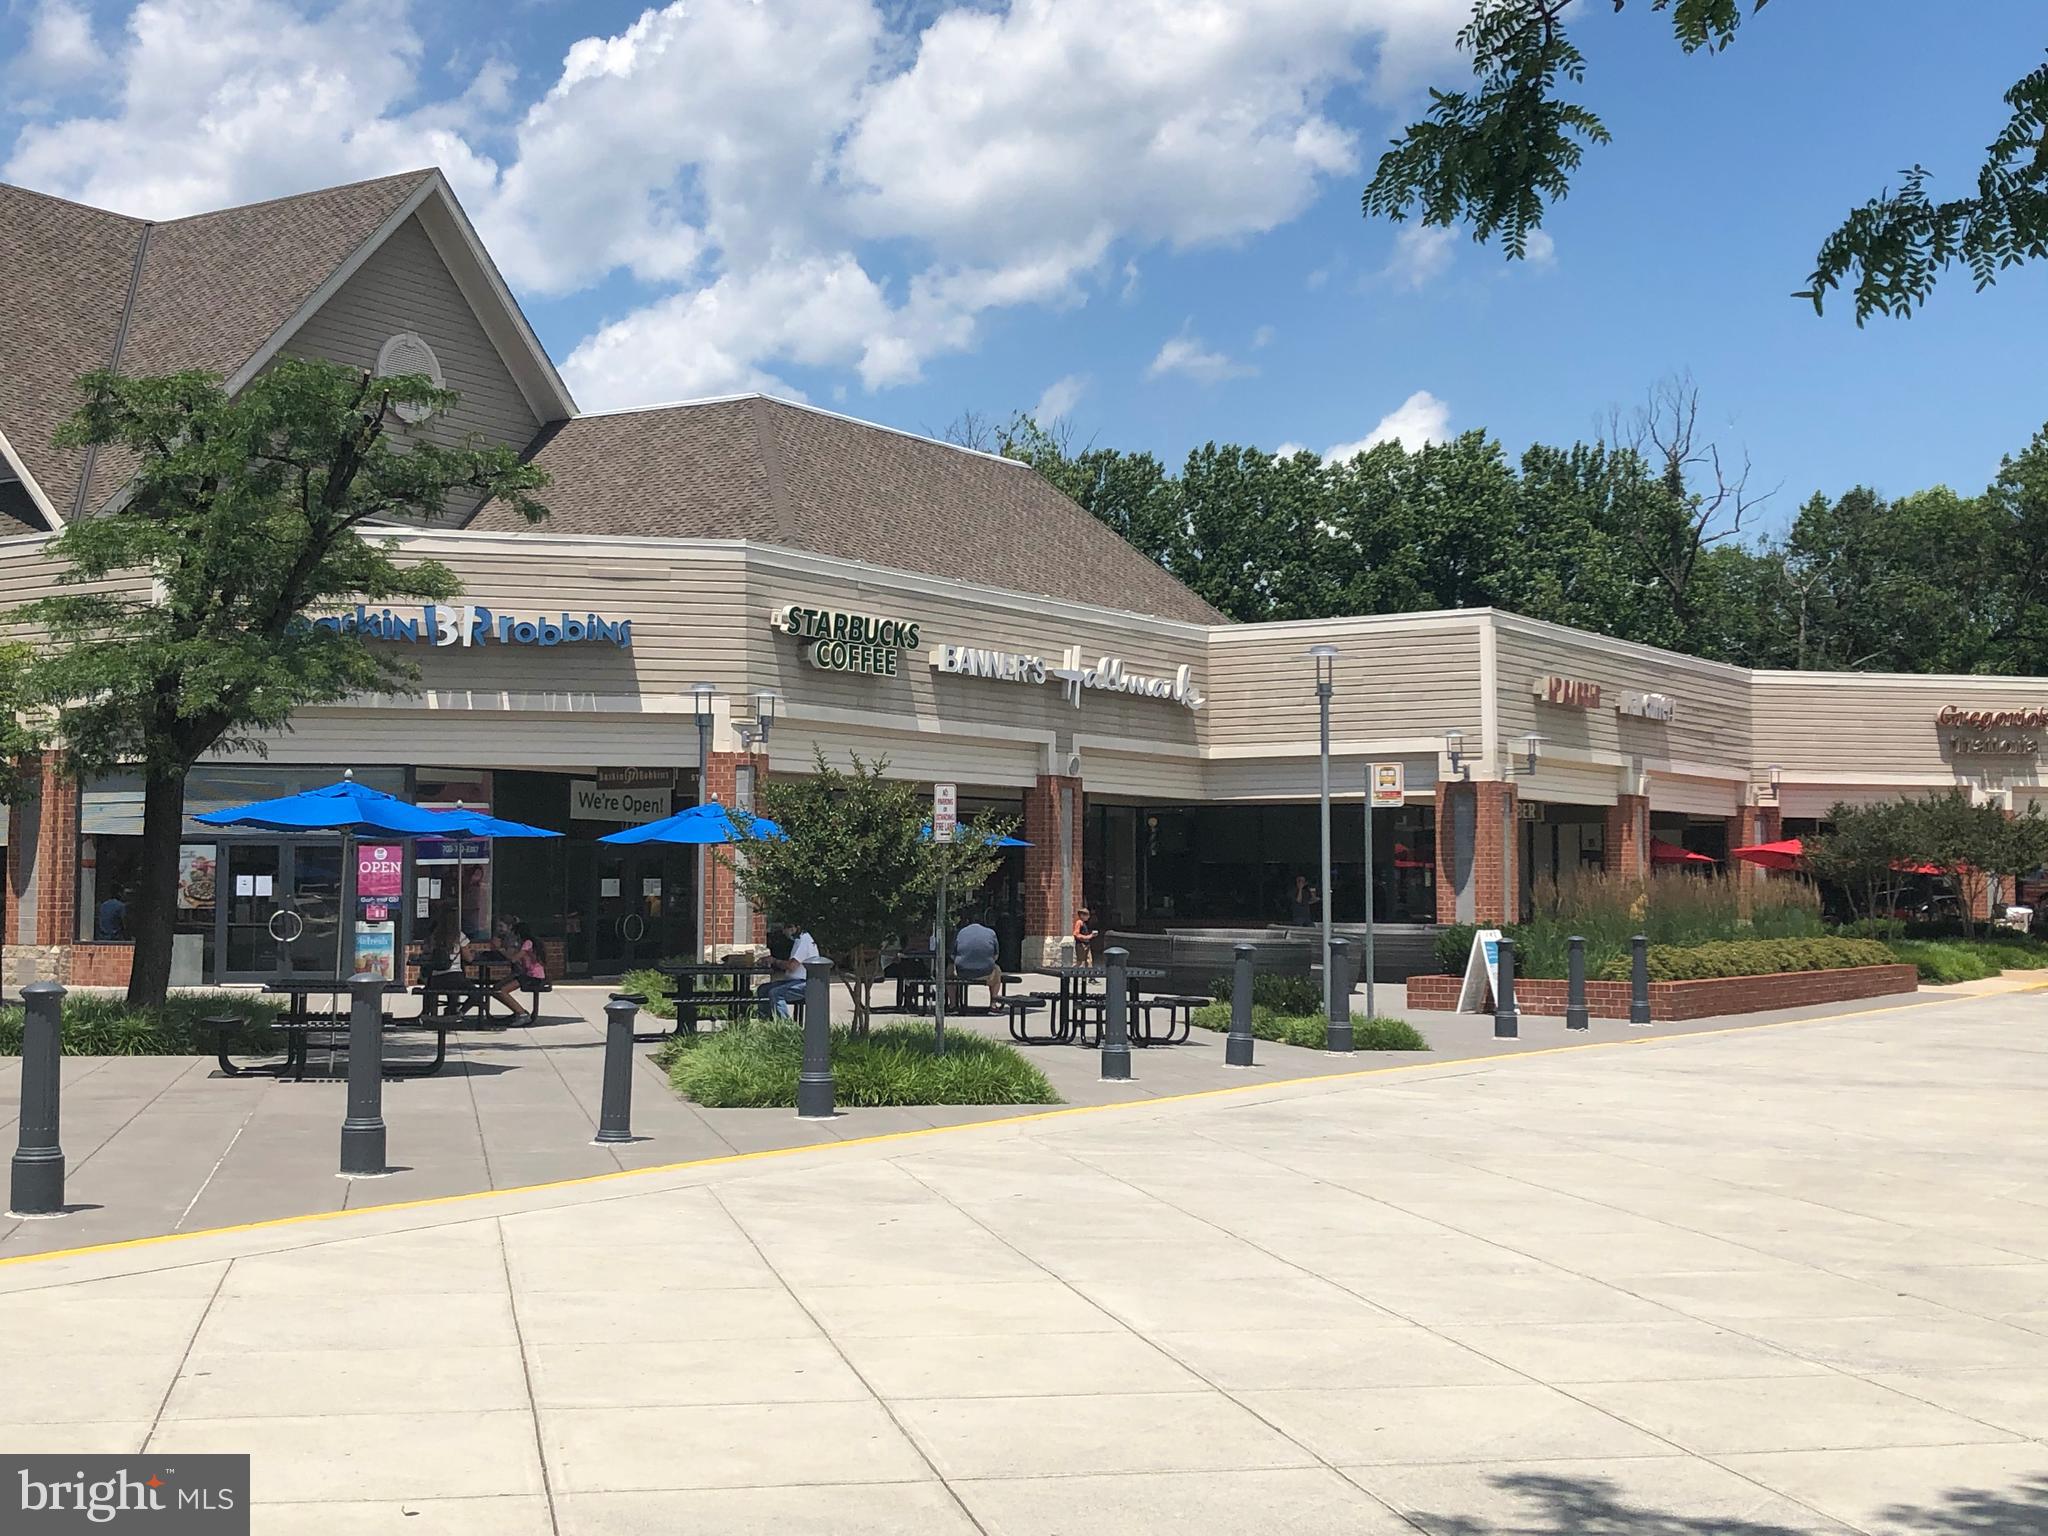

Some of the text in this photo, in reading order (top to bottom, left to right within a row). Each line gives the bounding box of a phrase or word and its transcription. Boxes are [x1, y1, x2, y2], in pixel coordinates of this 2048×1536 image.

[785, 605, 920, 650] STARBUCKS
[814, 639, 897, 677] COFFEE
[940, 644, 1206, 710] BANNER'S Hallmark
[579, 791, 664, 816] We're Open!
[360, 861, 402, 873] OPEN
